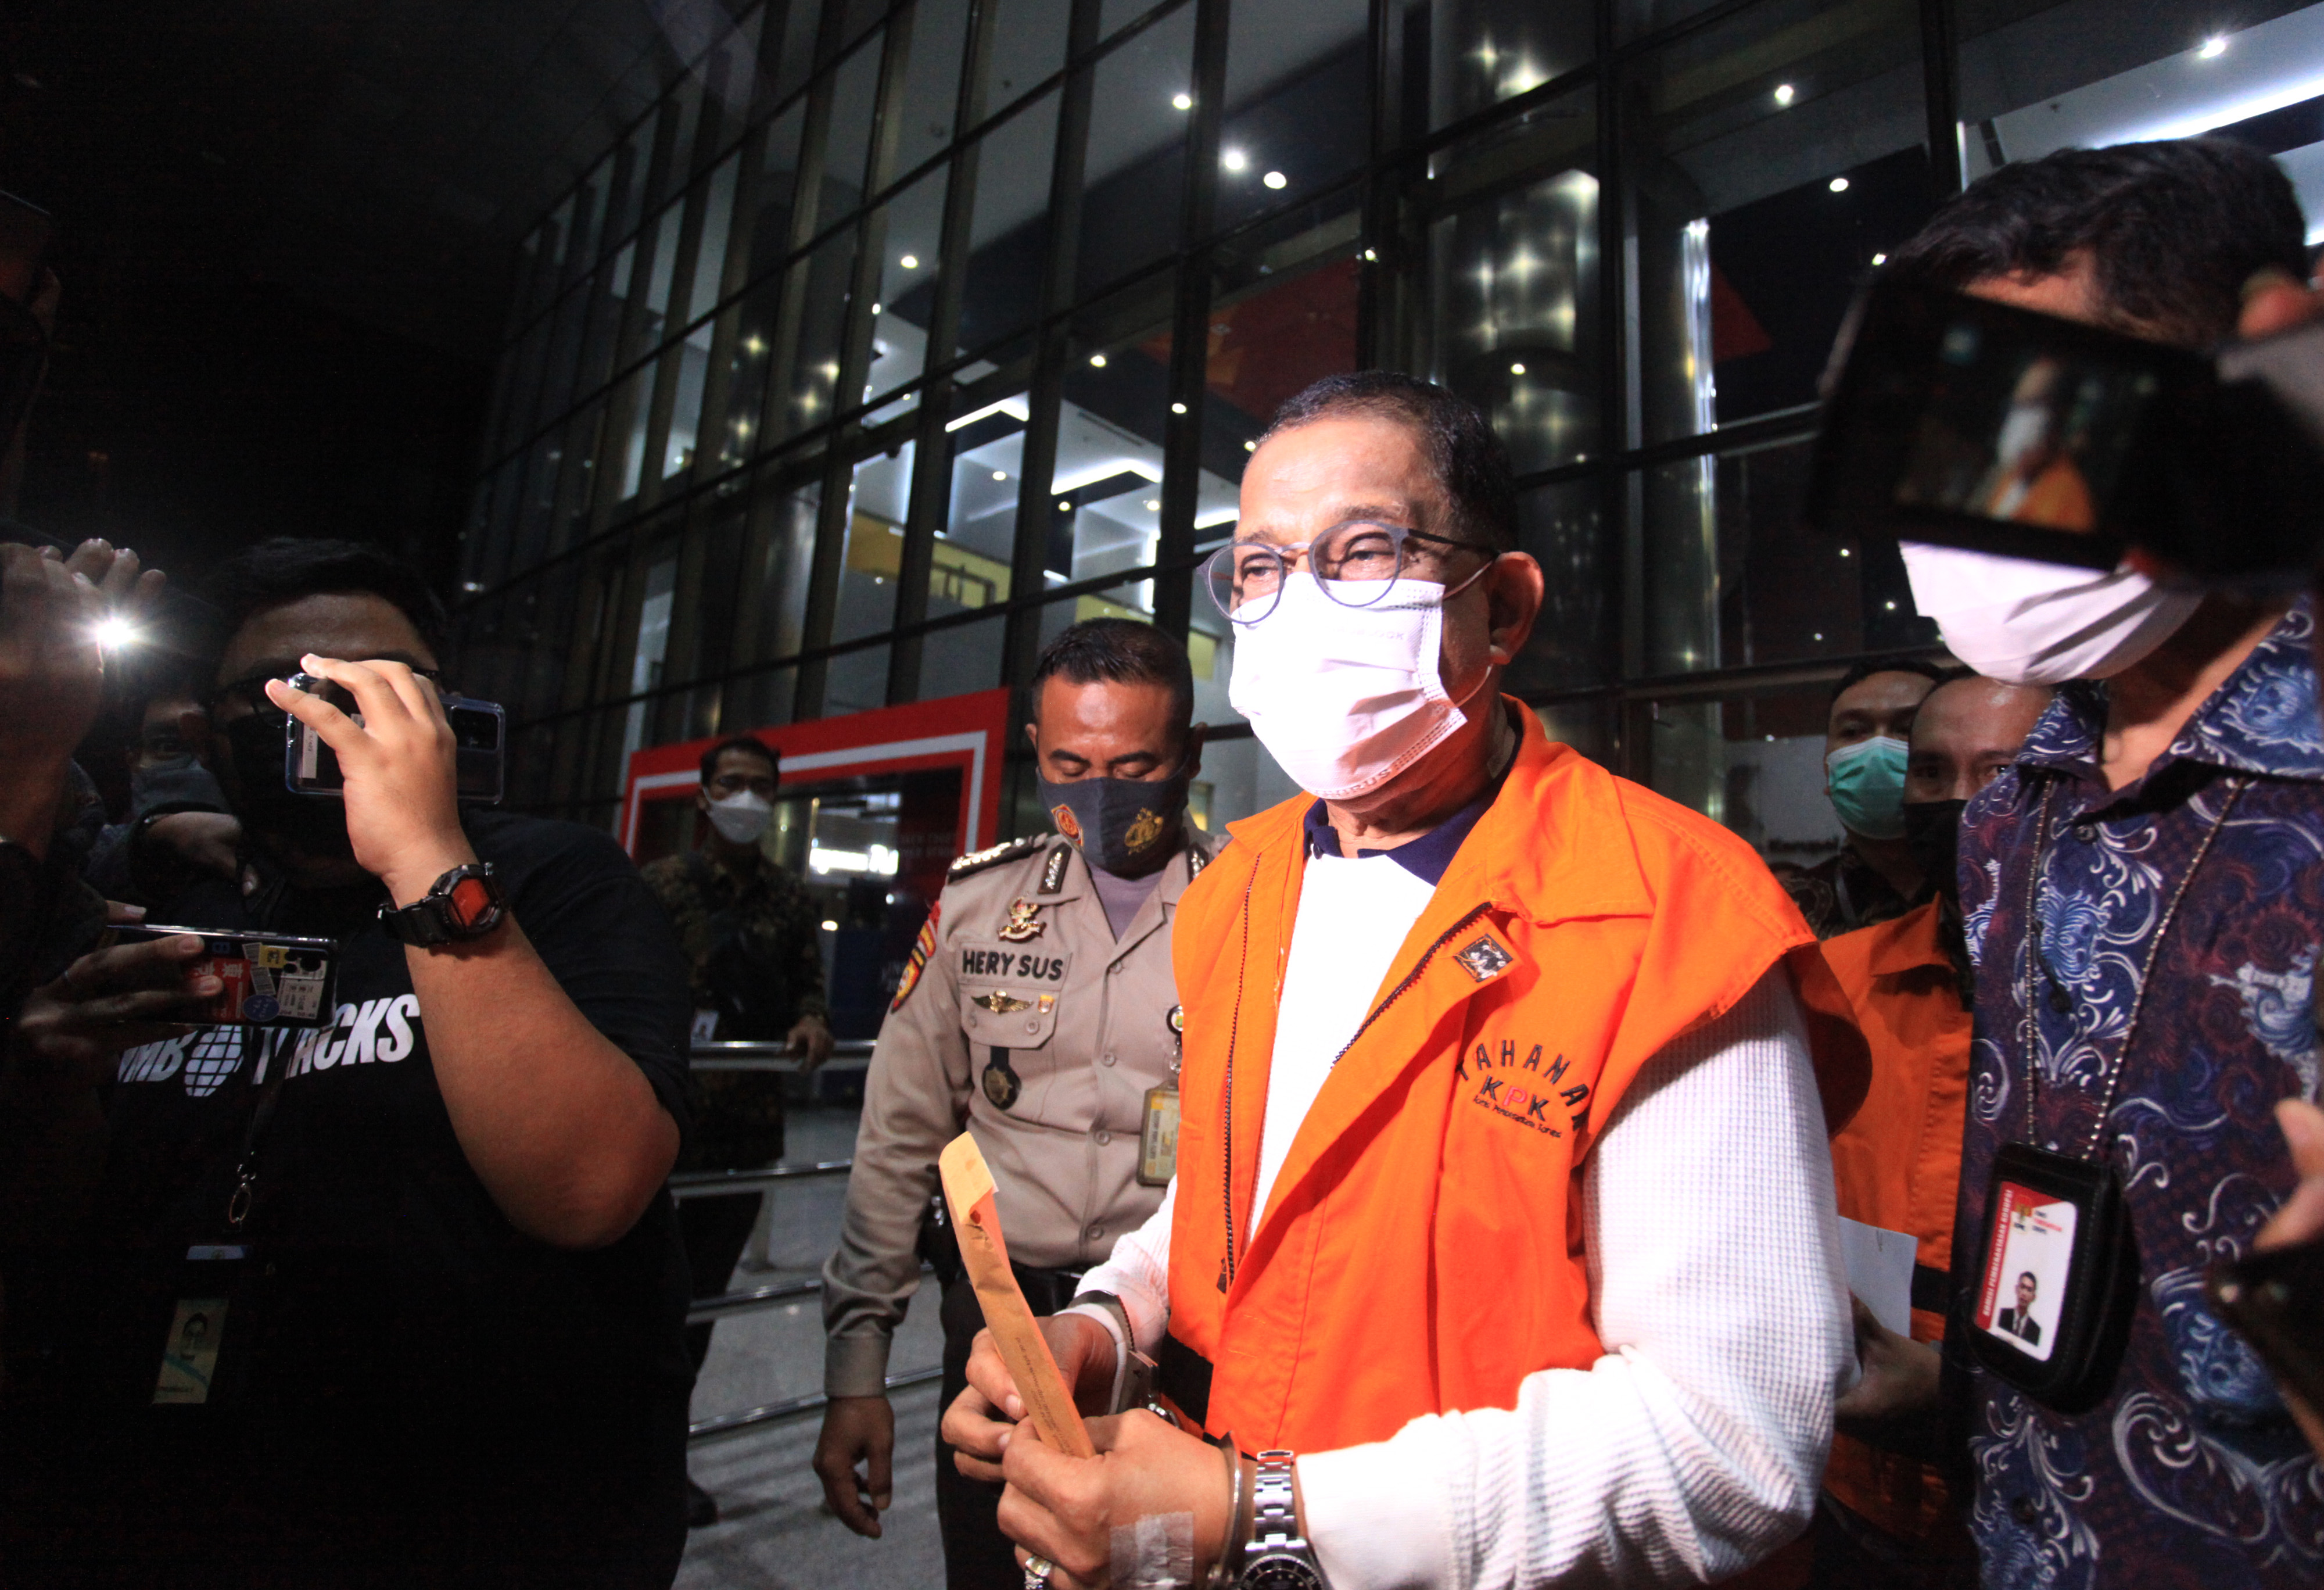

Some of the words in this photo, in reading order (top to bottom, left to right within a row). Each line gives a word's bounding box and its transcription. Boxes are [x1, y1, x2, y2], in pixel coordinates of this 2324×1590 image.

[962, 950, 1015, 976] HERY
[1017, 954, 1063, 981] SUS
[252, 993, 420, 1085] TACKS
[1480, 1075, 1549, 1122] KPK
